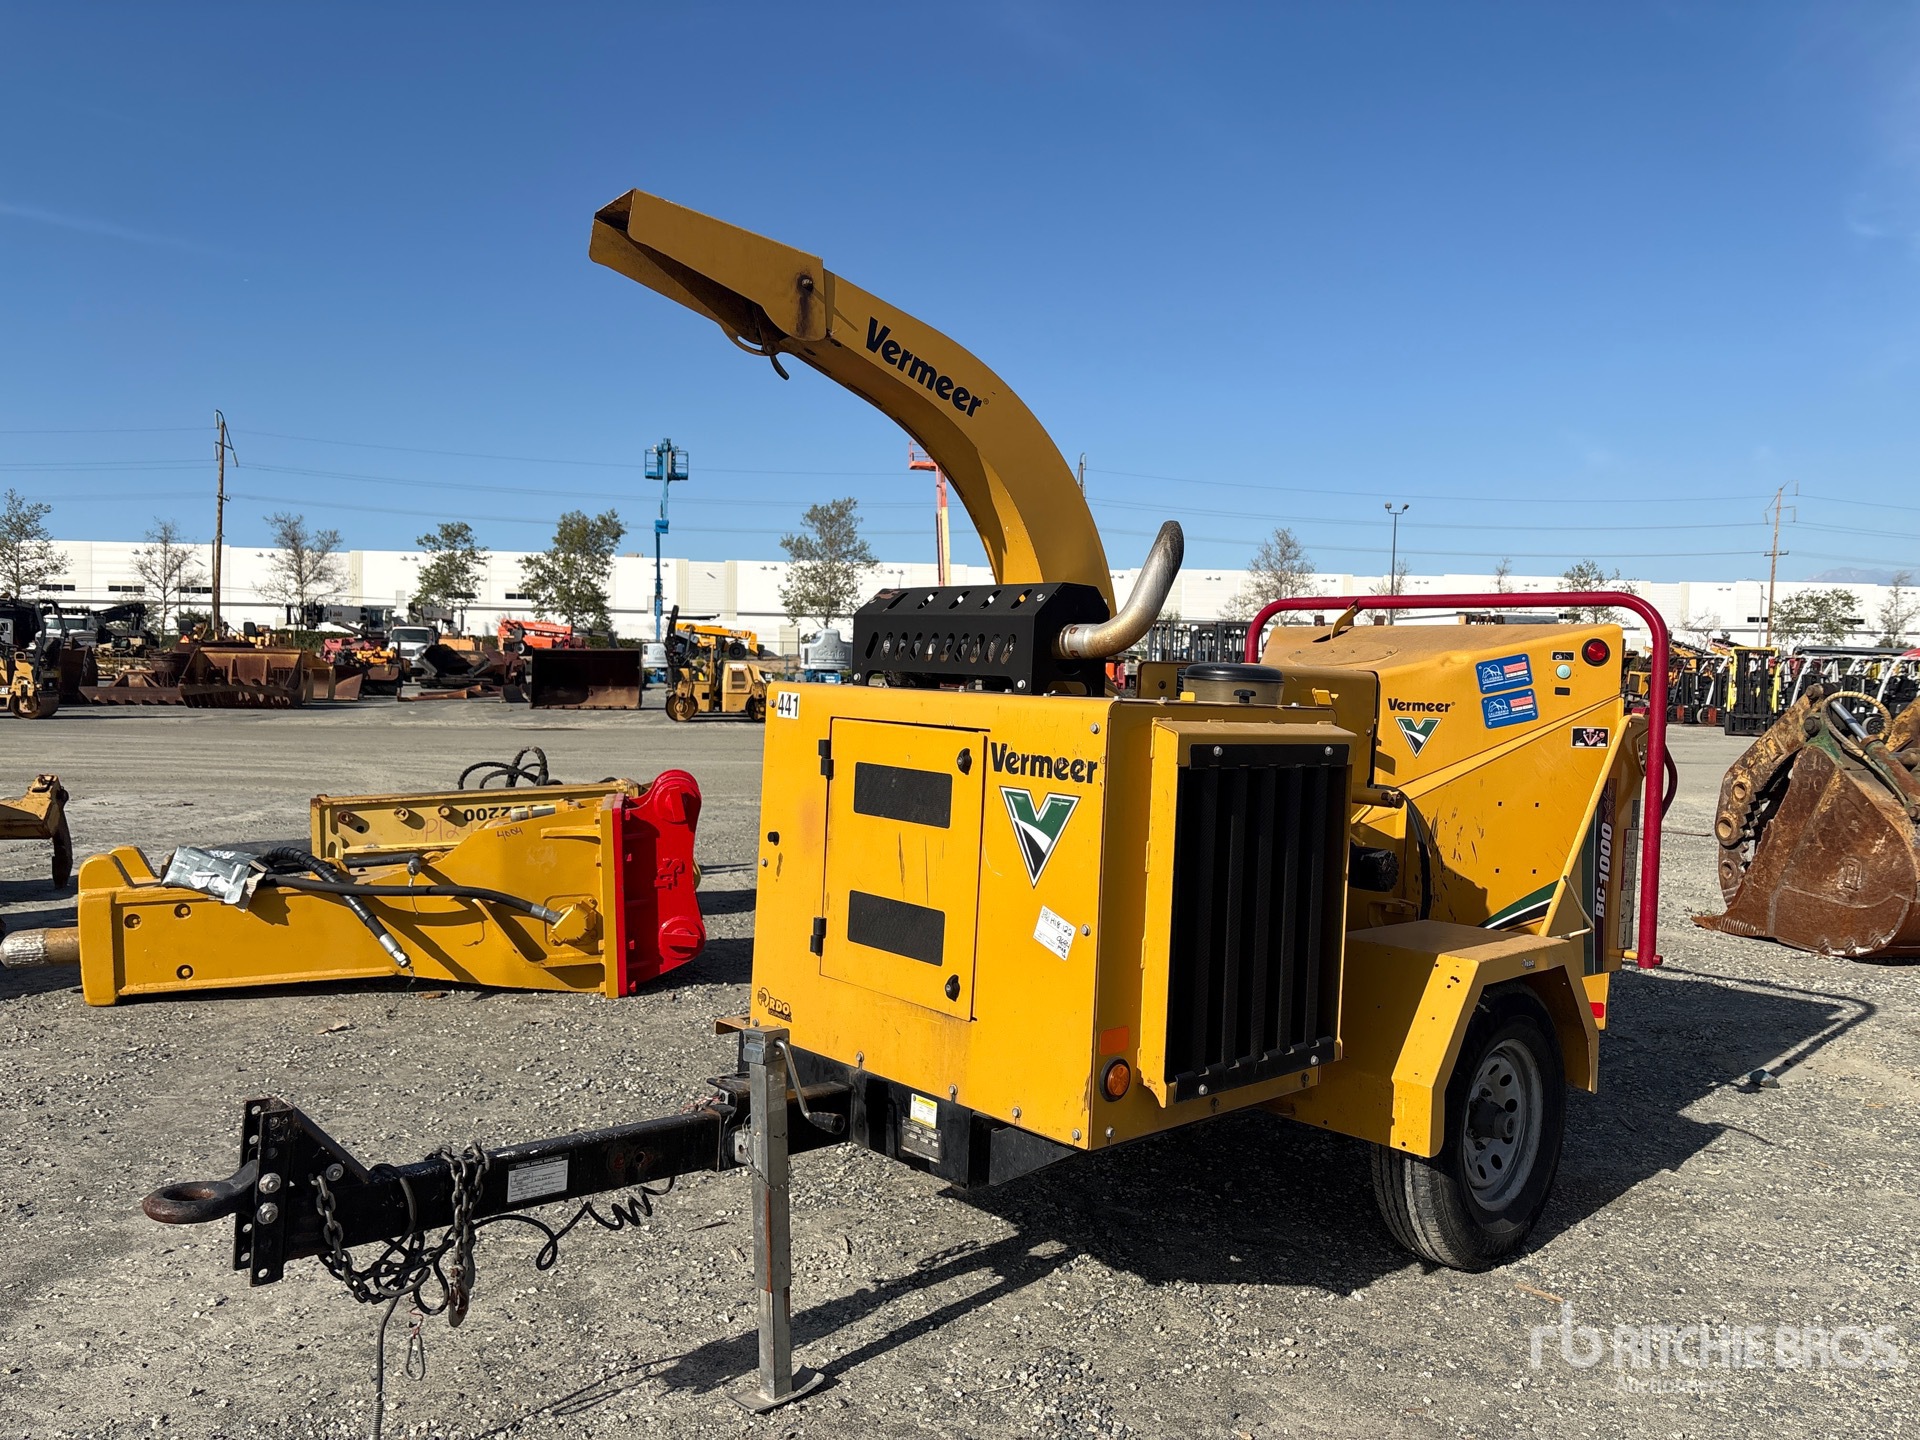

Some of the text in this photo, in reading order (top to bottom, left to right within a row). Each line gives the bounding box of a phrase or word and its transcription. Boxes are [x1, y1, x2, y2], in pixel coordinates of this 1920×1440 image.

[866, 316, 982, 418] Vermeer
[778, 693, 799, 718] 441
[1387, 697, 1451, 713] Vermeer
[990, 741, 1098, 784] Vermeer
[1596, 822, 1613, 918] BC 1000
[769, 996, 791, 1016] RDO
